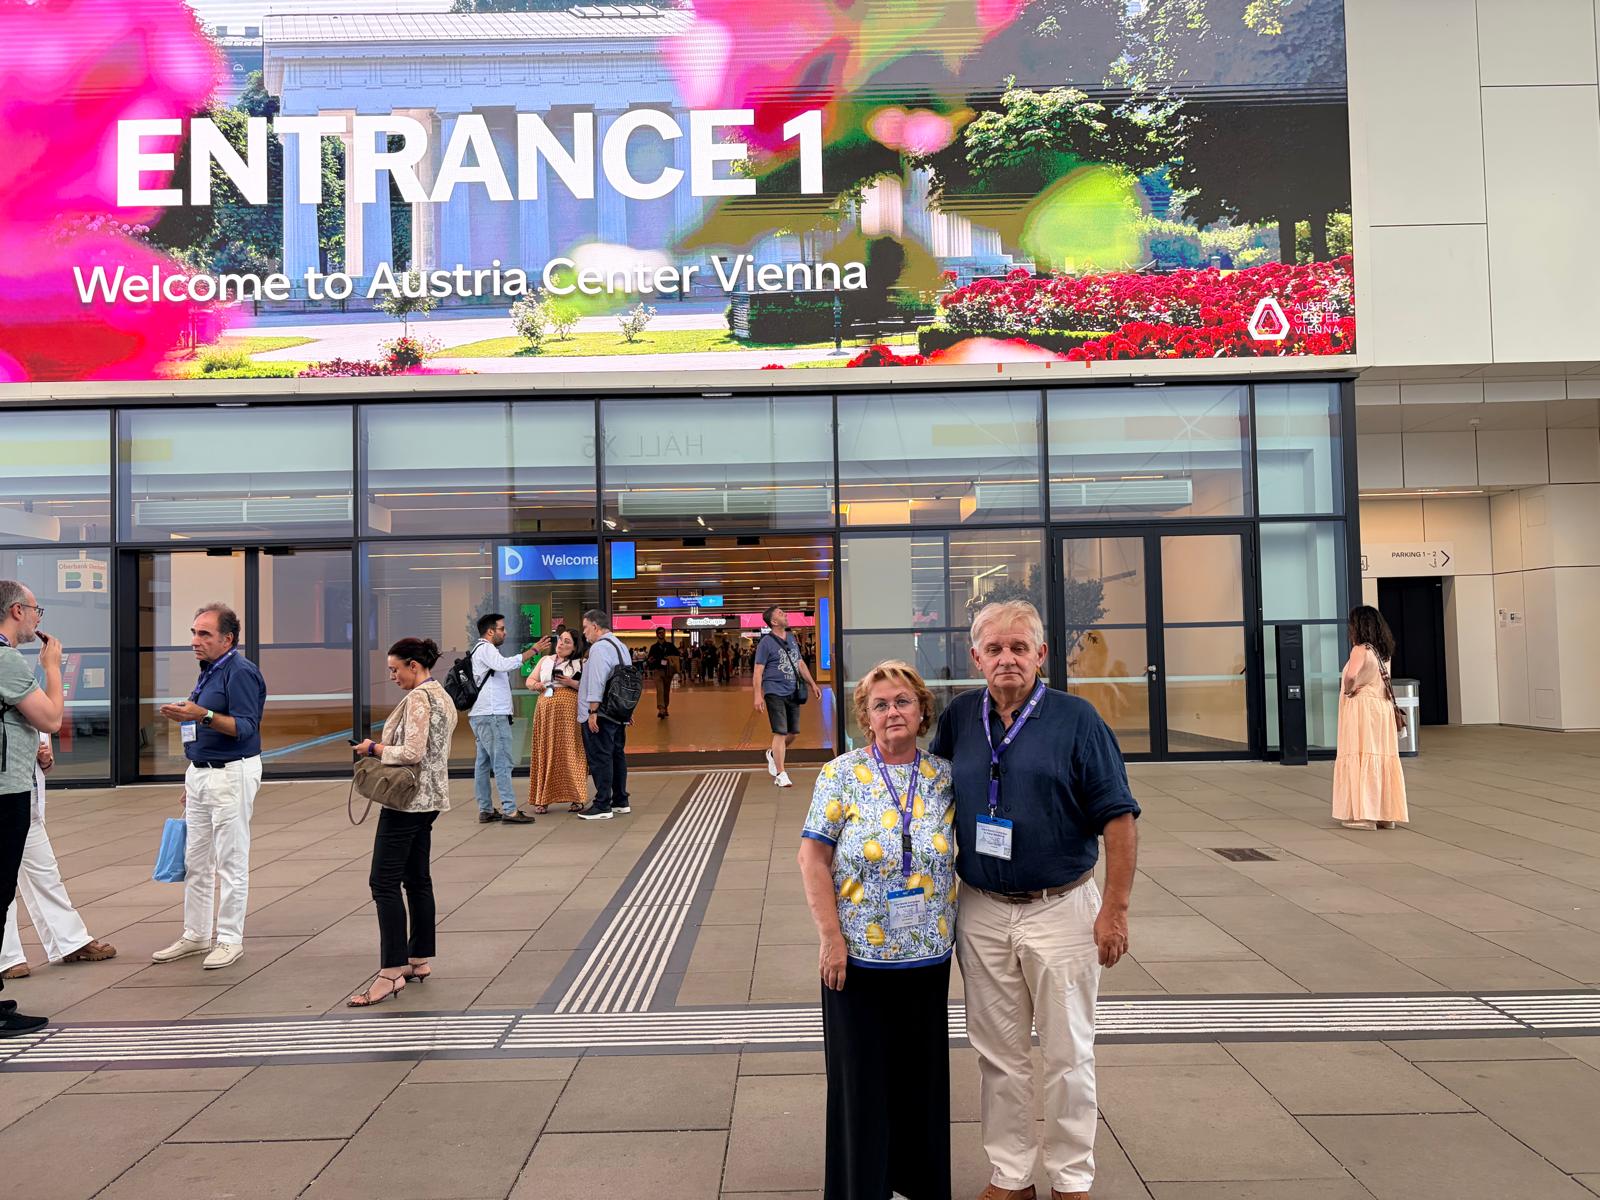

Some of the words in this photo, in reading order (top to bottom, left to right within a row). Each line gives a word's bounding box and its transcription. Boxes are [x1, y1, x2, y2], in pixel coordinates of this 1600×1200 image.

[117, 108, 757, 207] ENTRANCE
[783, 110, 824, 195] 1
[73, 265, 291, 304] Welcome
[303, 266, 353, 301] to
[366, 260, 527, 301] Austria
[542, 257, 699, 296] Center
[711, 254, 868, 293] Vienna
[1294, 301, 1340, 312] AUSTRIA
[1294, 325, 1340, 335] VIENNA
[541, 553, 599, 566] Welcome
